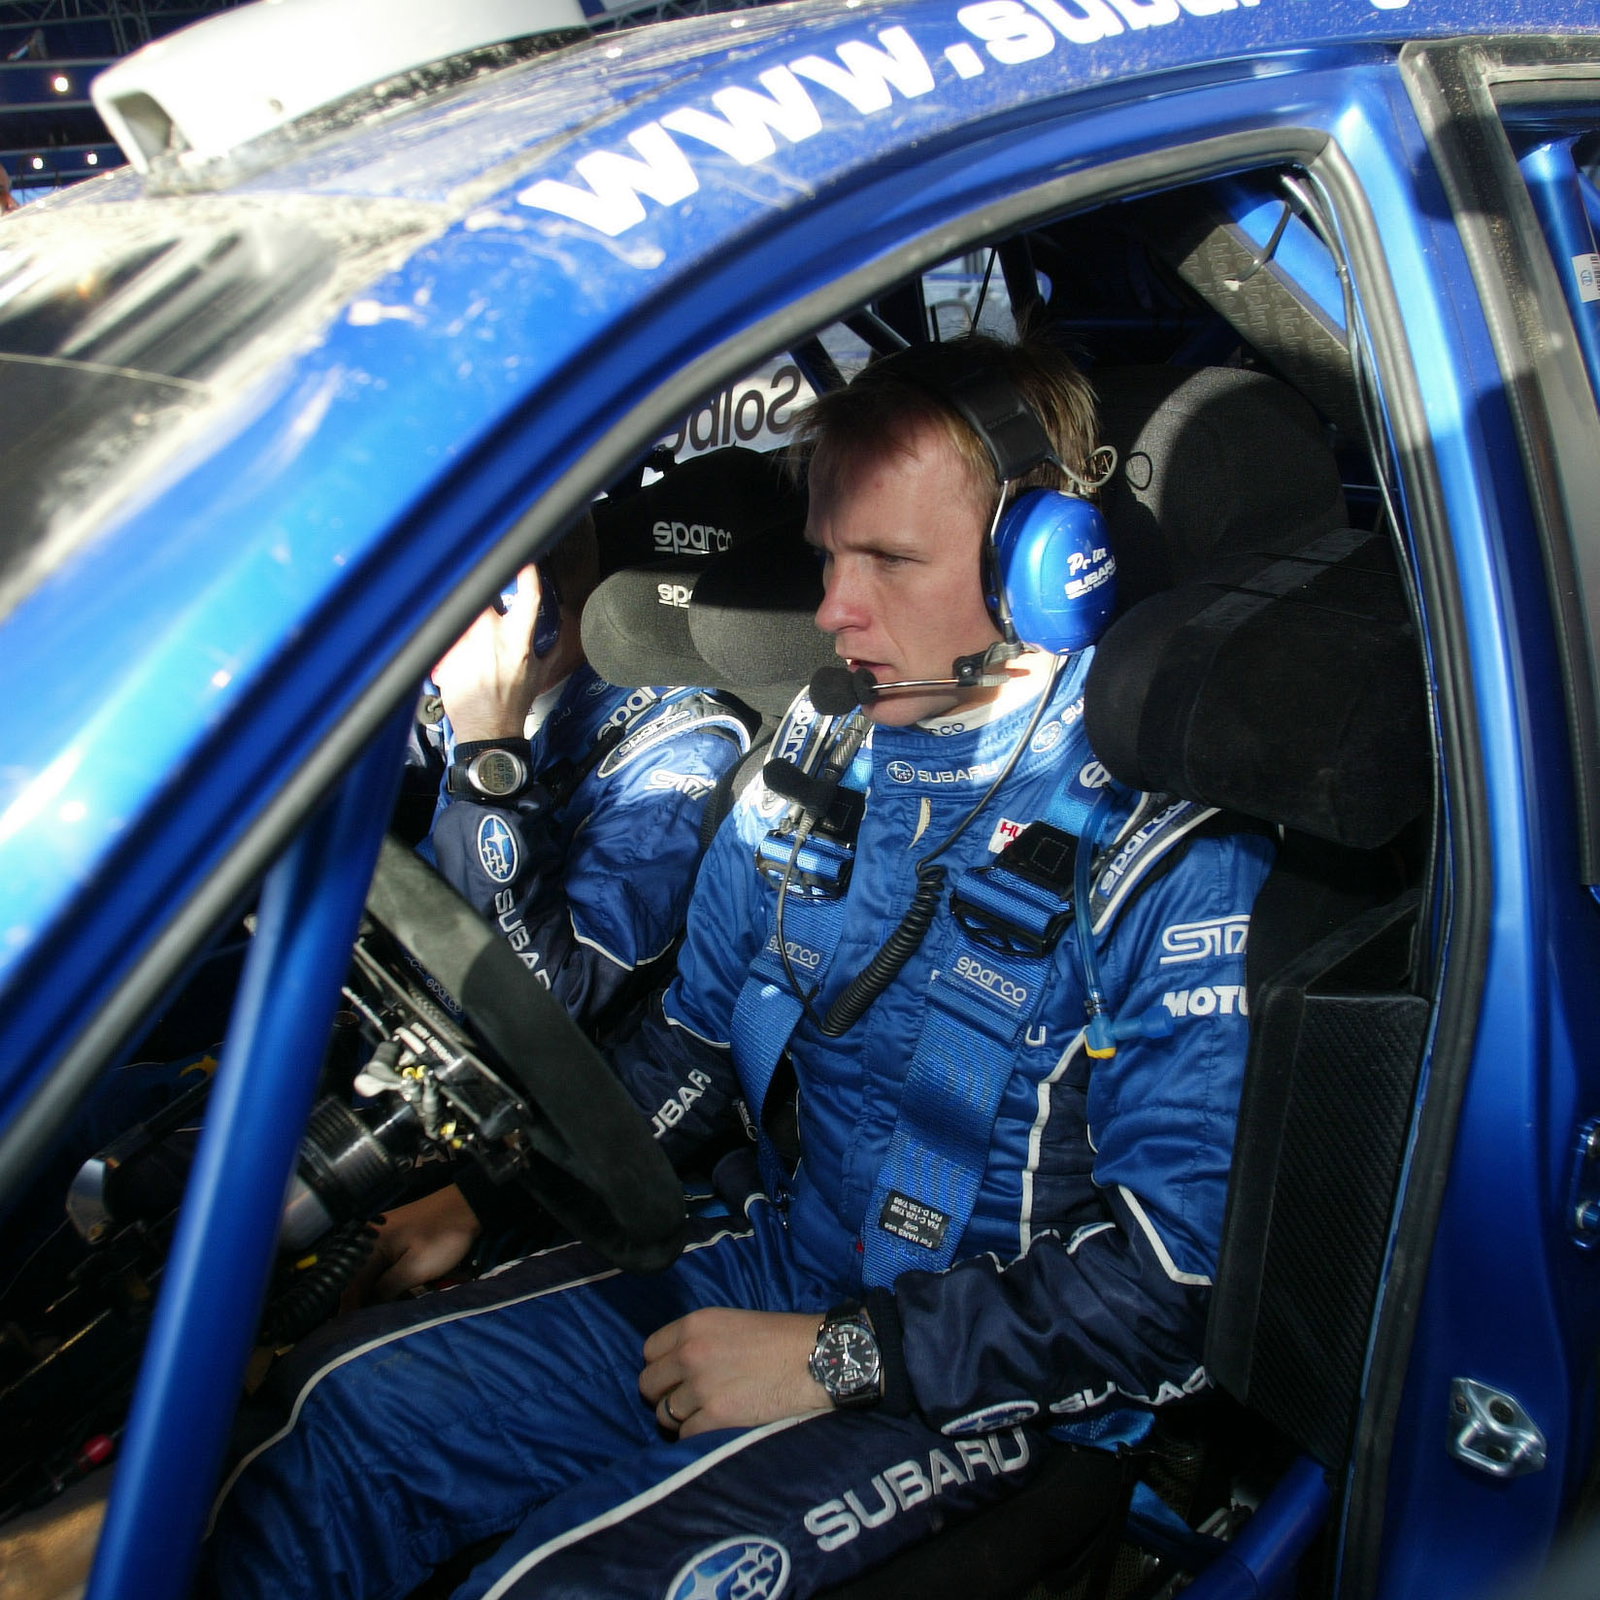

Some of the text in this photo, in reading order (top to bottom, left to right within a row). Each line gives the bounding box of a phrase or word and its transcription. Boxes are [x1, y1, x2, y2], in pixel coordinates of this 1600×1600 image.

[917, 762, 1001, 784] SUBARU
[494, 887, 552, 991] SUBAR
[953, 956, 1027, 1007] sparco
[1161, 984, 1249, 1018] MOTU
[651, 1068, 713, 1139] UBAR
[803, 1427, 1031, 1552] SUBARU
